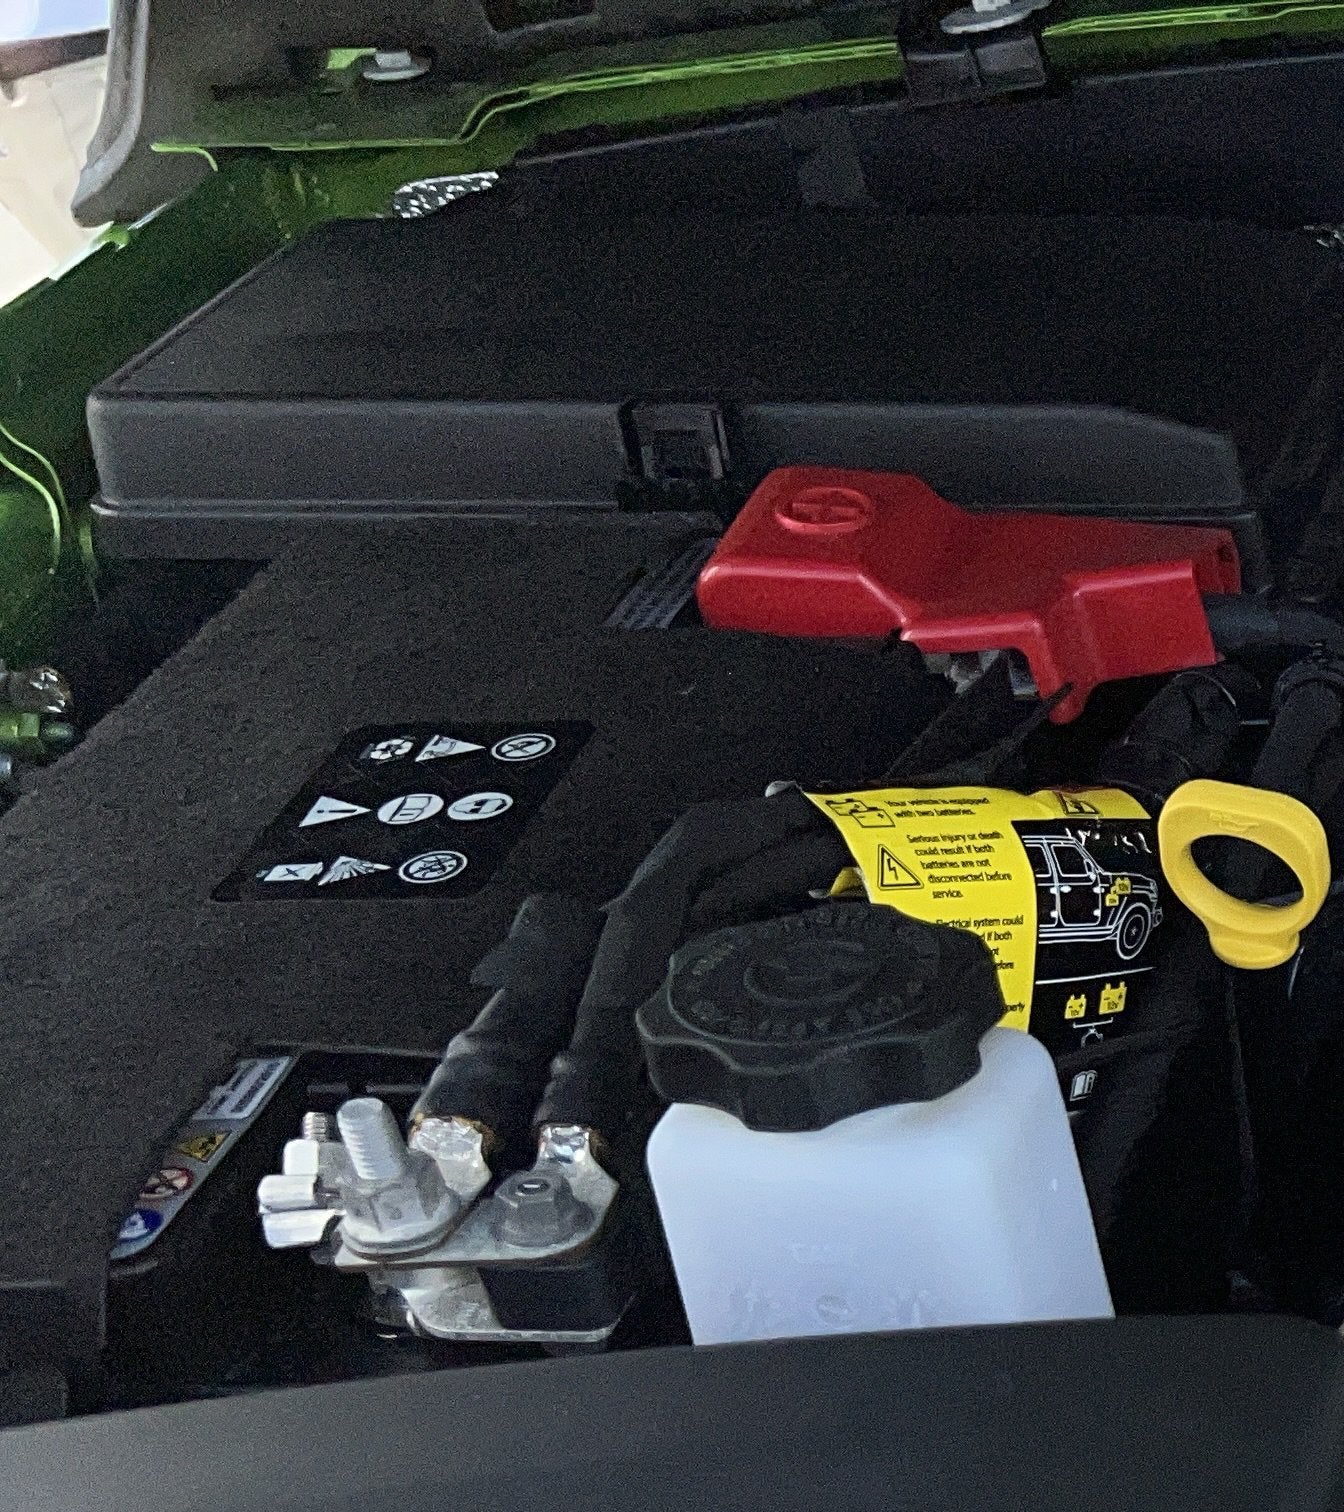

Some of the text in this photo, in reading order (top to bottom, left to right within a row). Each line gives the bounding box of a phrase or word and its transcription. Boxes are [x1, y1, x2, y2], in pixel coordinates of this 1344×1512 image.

[894, 809, 916, 818] with
[915, 809, 935, 817] two
[907, 834, 940, 844] Serious
[940, 832, 966, 844] injury
[978, 830, 1004, 840] death
[915, 846, 940, 856] could
[940, 845, 964, 855] result
[972, 843, 995, 854] both
[920, 857, 991, 870] batteries are not
[928, 870, 1012, 883] disconnected before
[932, 888, 964, 899] service.
[973, 917, 1001, 930] system
[1002, 914, 1024, 926] could
[994, 930, 1012, 941] both
